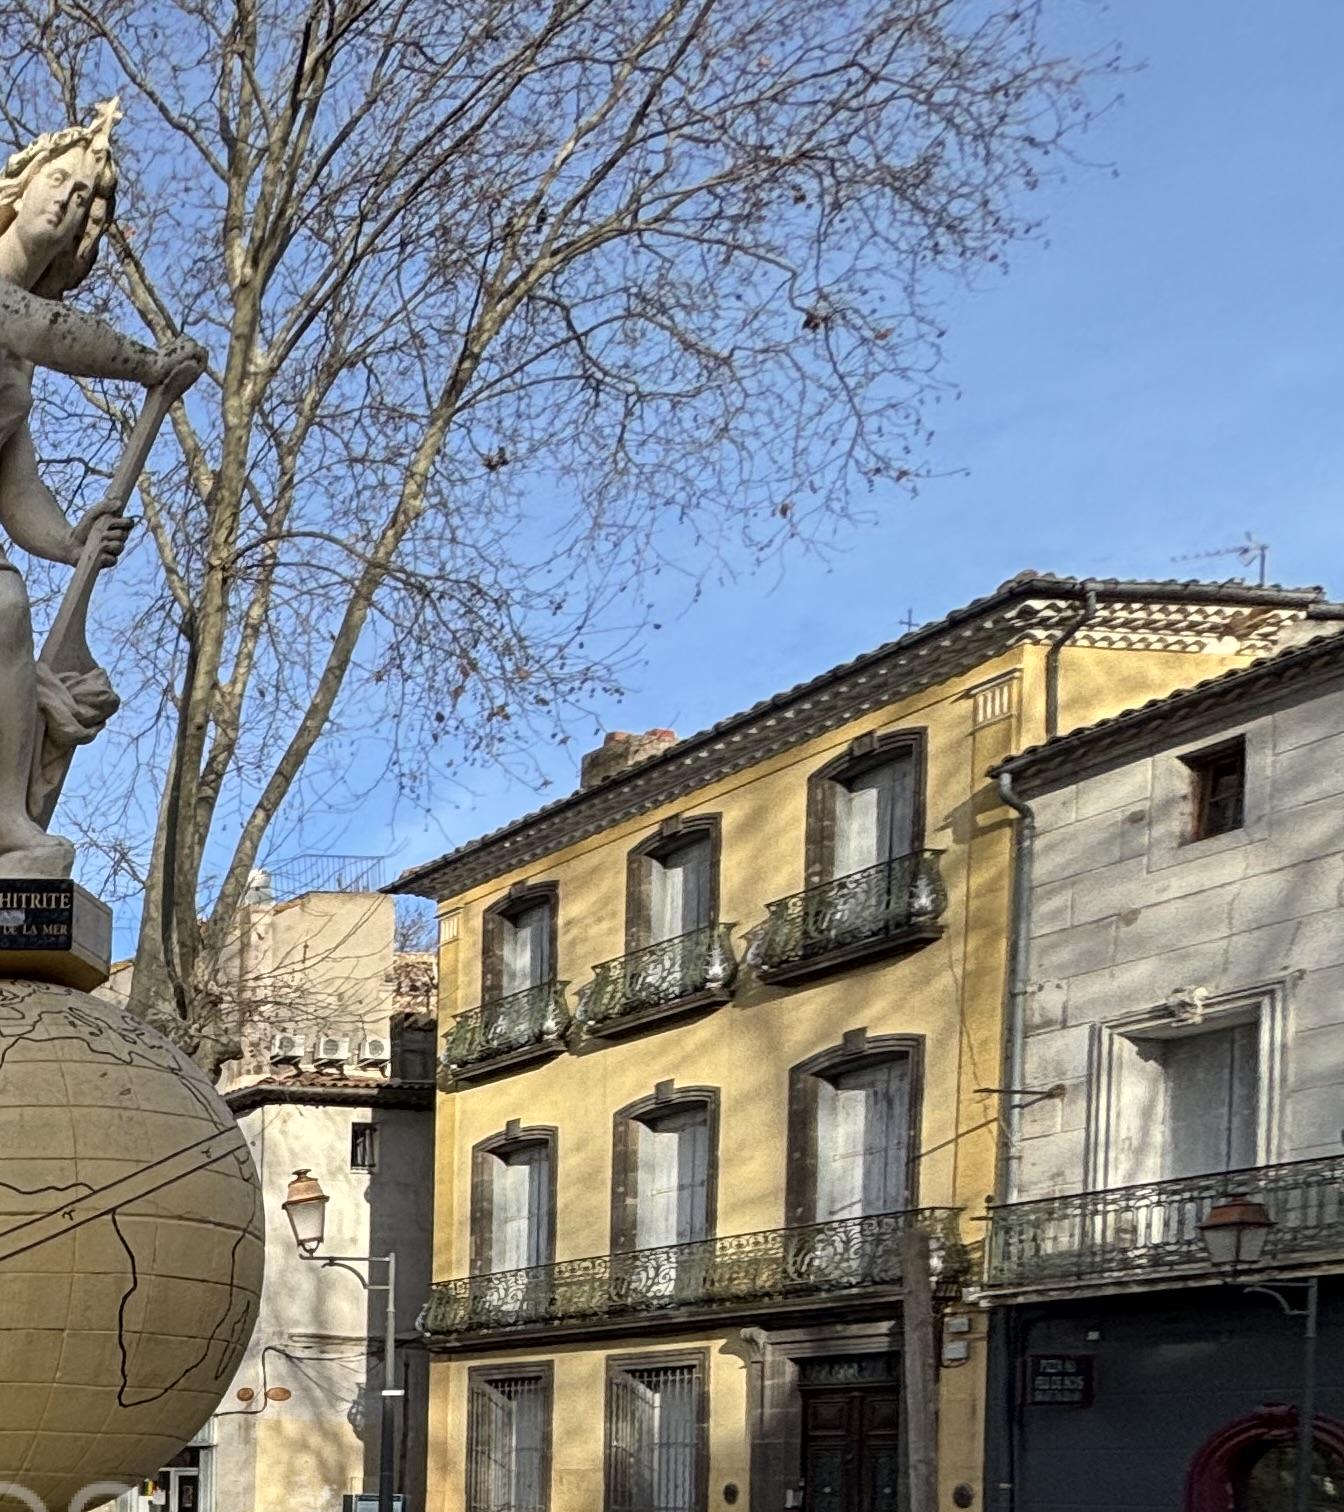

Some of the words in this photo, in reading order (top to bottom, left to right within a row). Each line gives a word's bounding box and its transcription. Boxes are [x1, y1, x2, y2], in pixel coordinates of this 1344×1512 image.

[2, 925, 17, 935] DE
[22, 924, 38, 935] LA
[42, 924, 68, 935] MER
